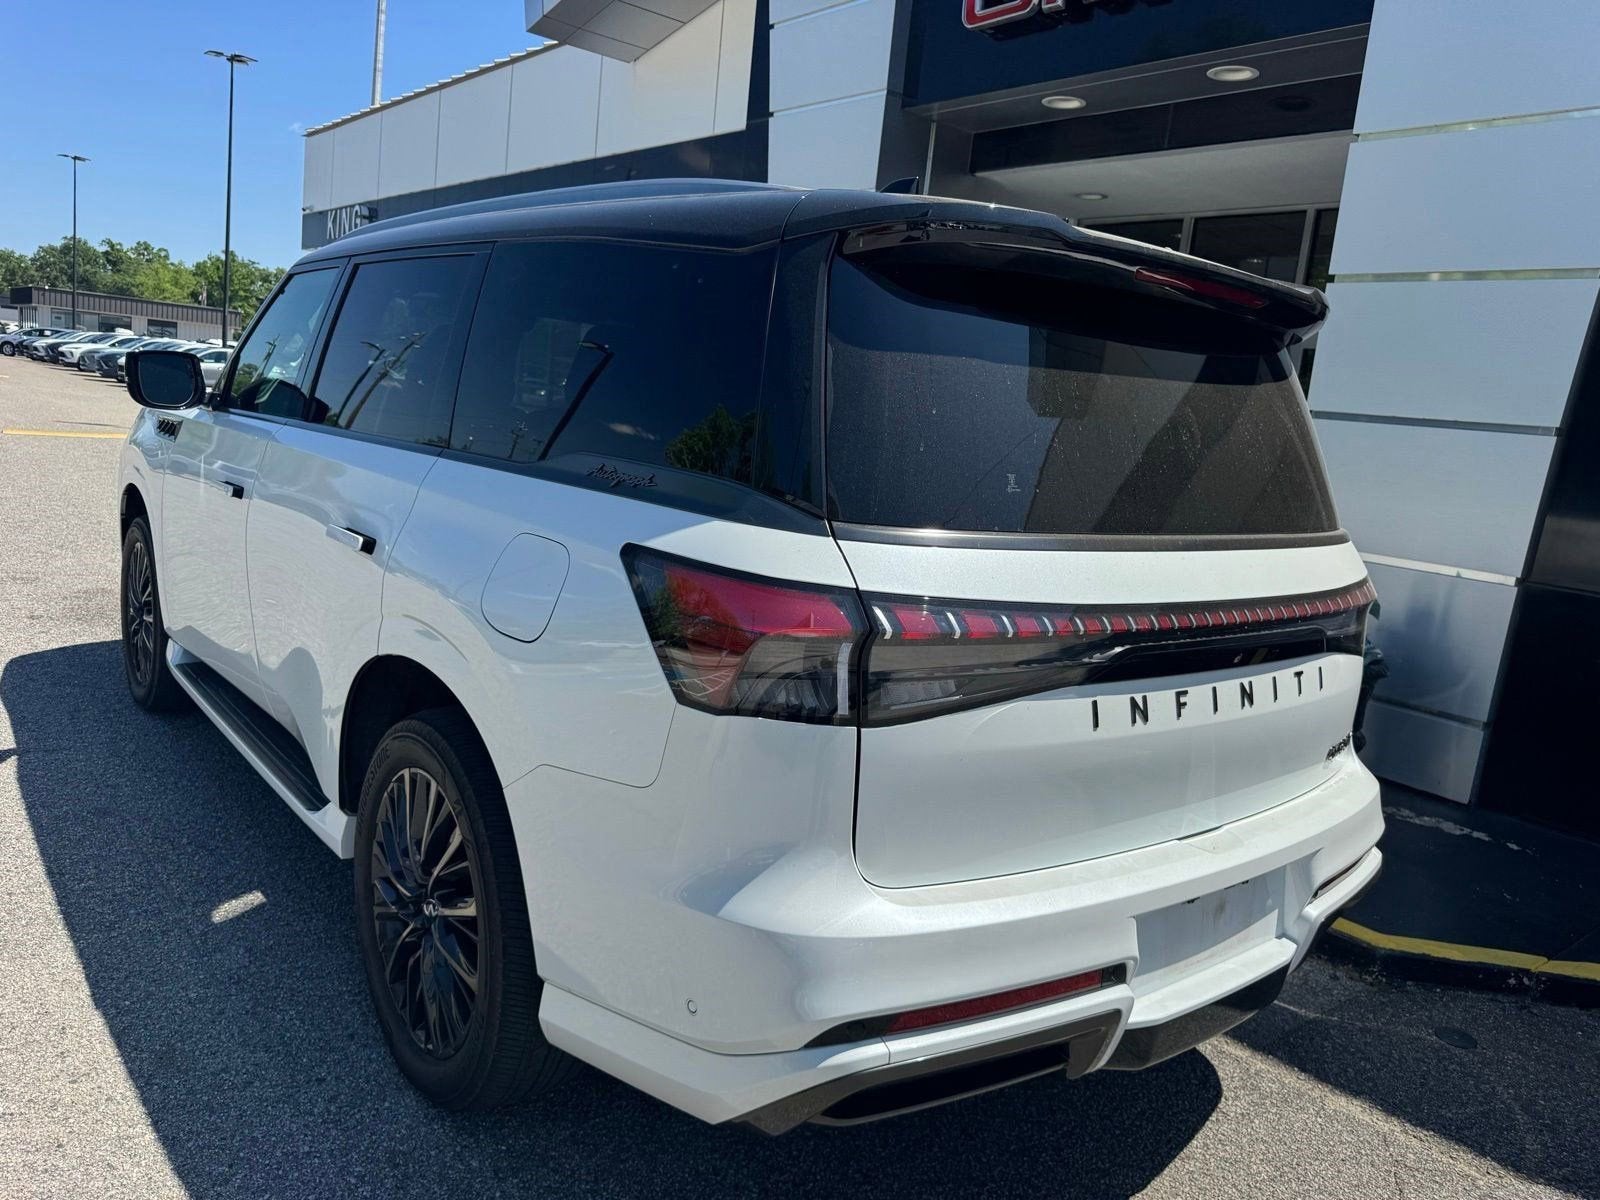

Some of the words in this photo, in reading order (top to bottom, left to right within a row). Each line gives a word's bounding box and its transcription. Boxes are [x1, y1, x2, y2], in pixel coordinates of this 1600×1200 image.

[326, 204, 361, 240] KING
[585, 463, 657, 488] Autograph
[1091, 666, 1323, 732] INFINITI
